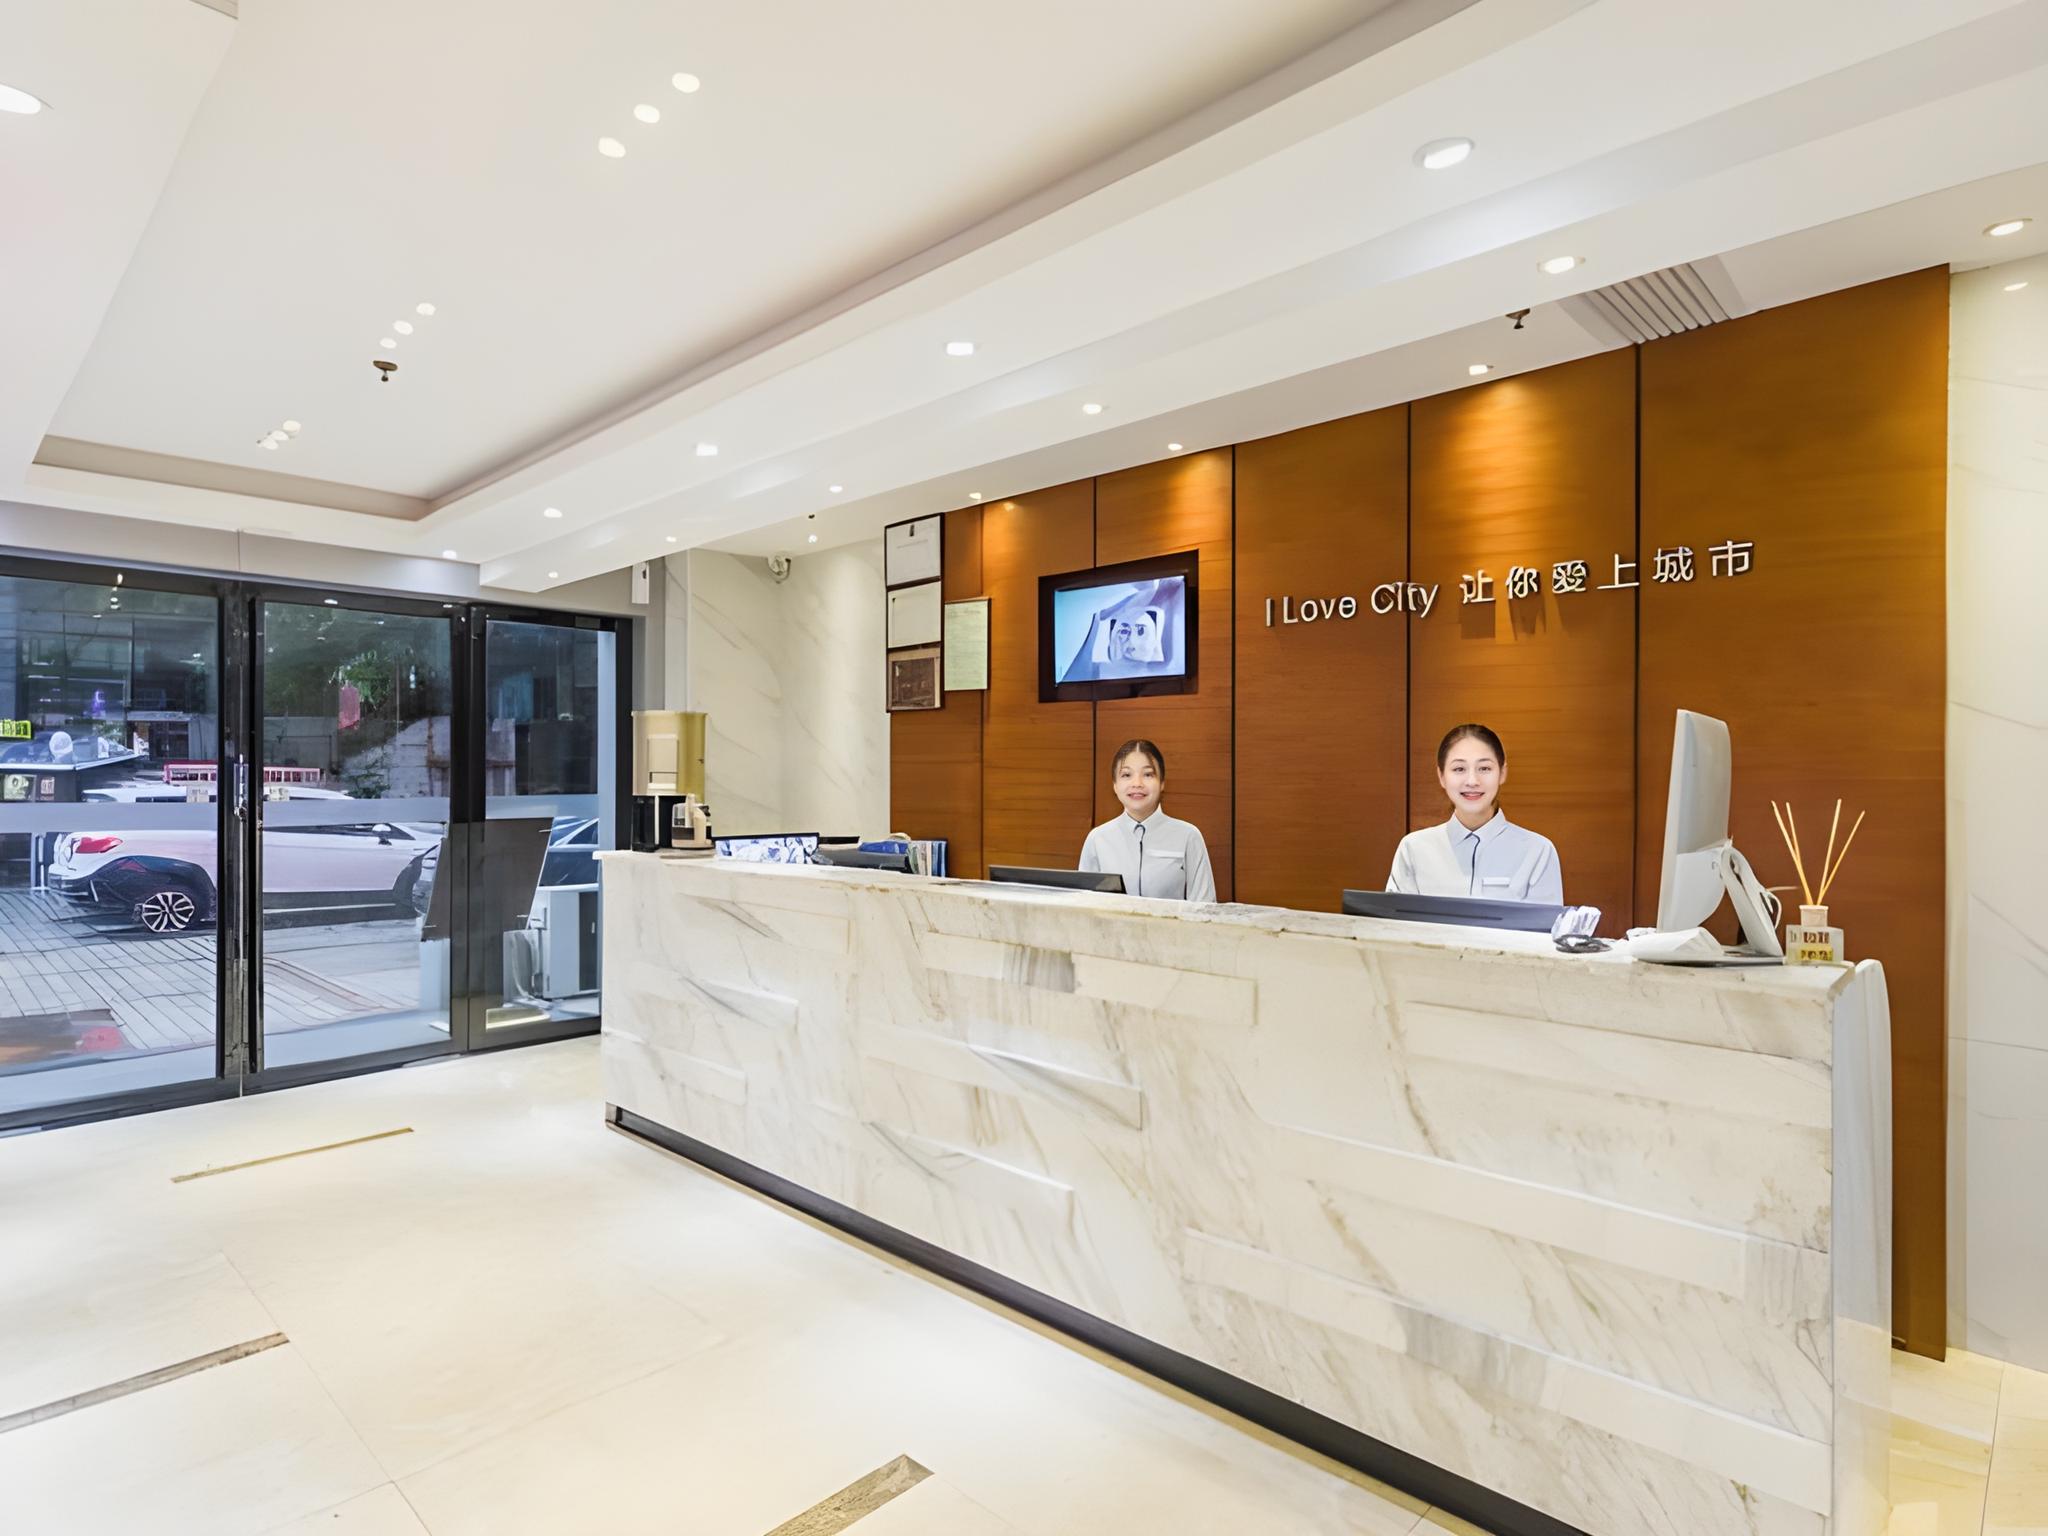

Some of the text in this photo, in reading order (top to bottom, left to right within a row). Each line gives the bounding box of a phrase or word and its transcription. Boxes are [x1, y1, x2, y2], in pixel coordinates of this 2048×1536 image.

[1264, 597, 1273, 627] I
[1282, 596, 1357, 624] Love
[1370, 581, 1439, 619] City
